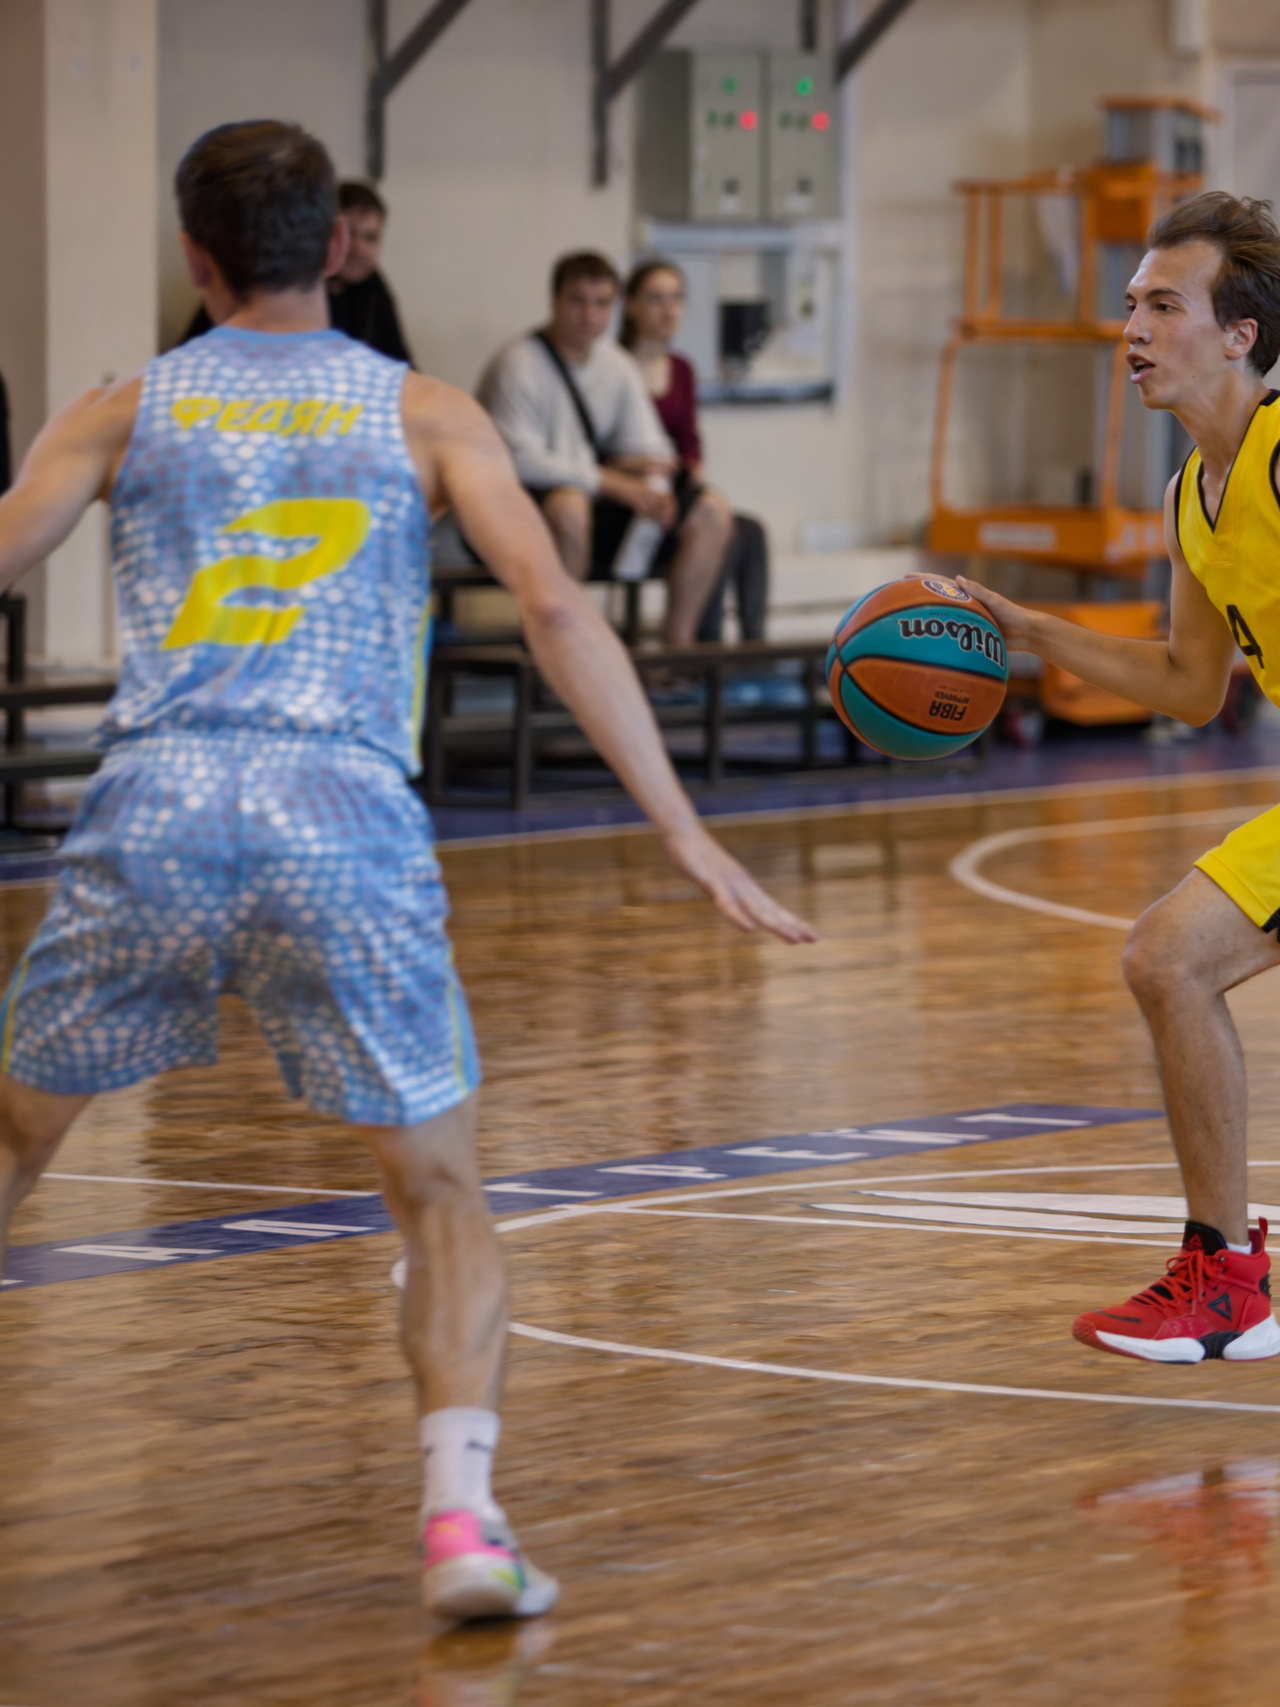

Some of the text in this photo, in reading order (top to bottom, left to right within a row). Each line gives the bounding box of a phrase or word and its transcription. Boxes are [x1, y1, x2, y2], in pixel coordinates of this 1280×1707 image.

[170, 397, 364, 438] ФЕДЯН
[160, 498, 371, 650] 2
[898, 617, 1006, 669] Wilson
[1226, 604, 1265, 669] 4
[928, 701, 967, 721] FIBA
